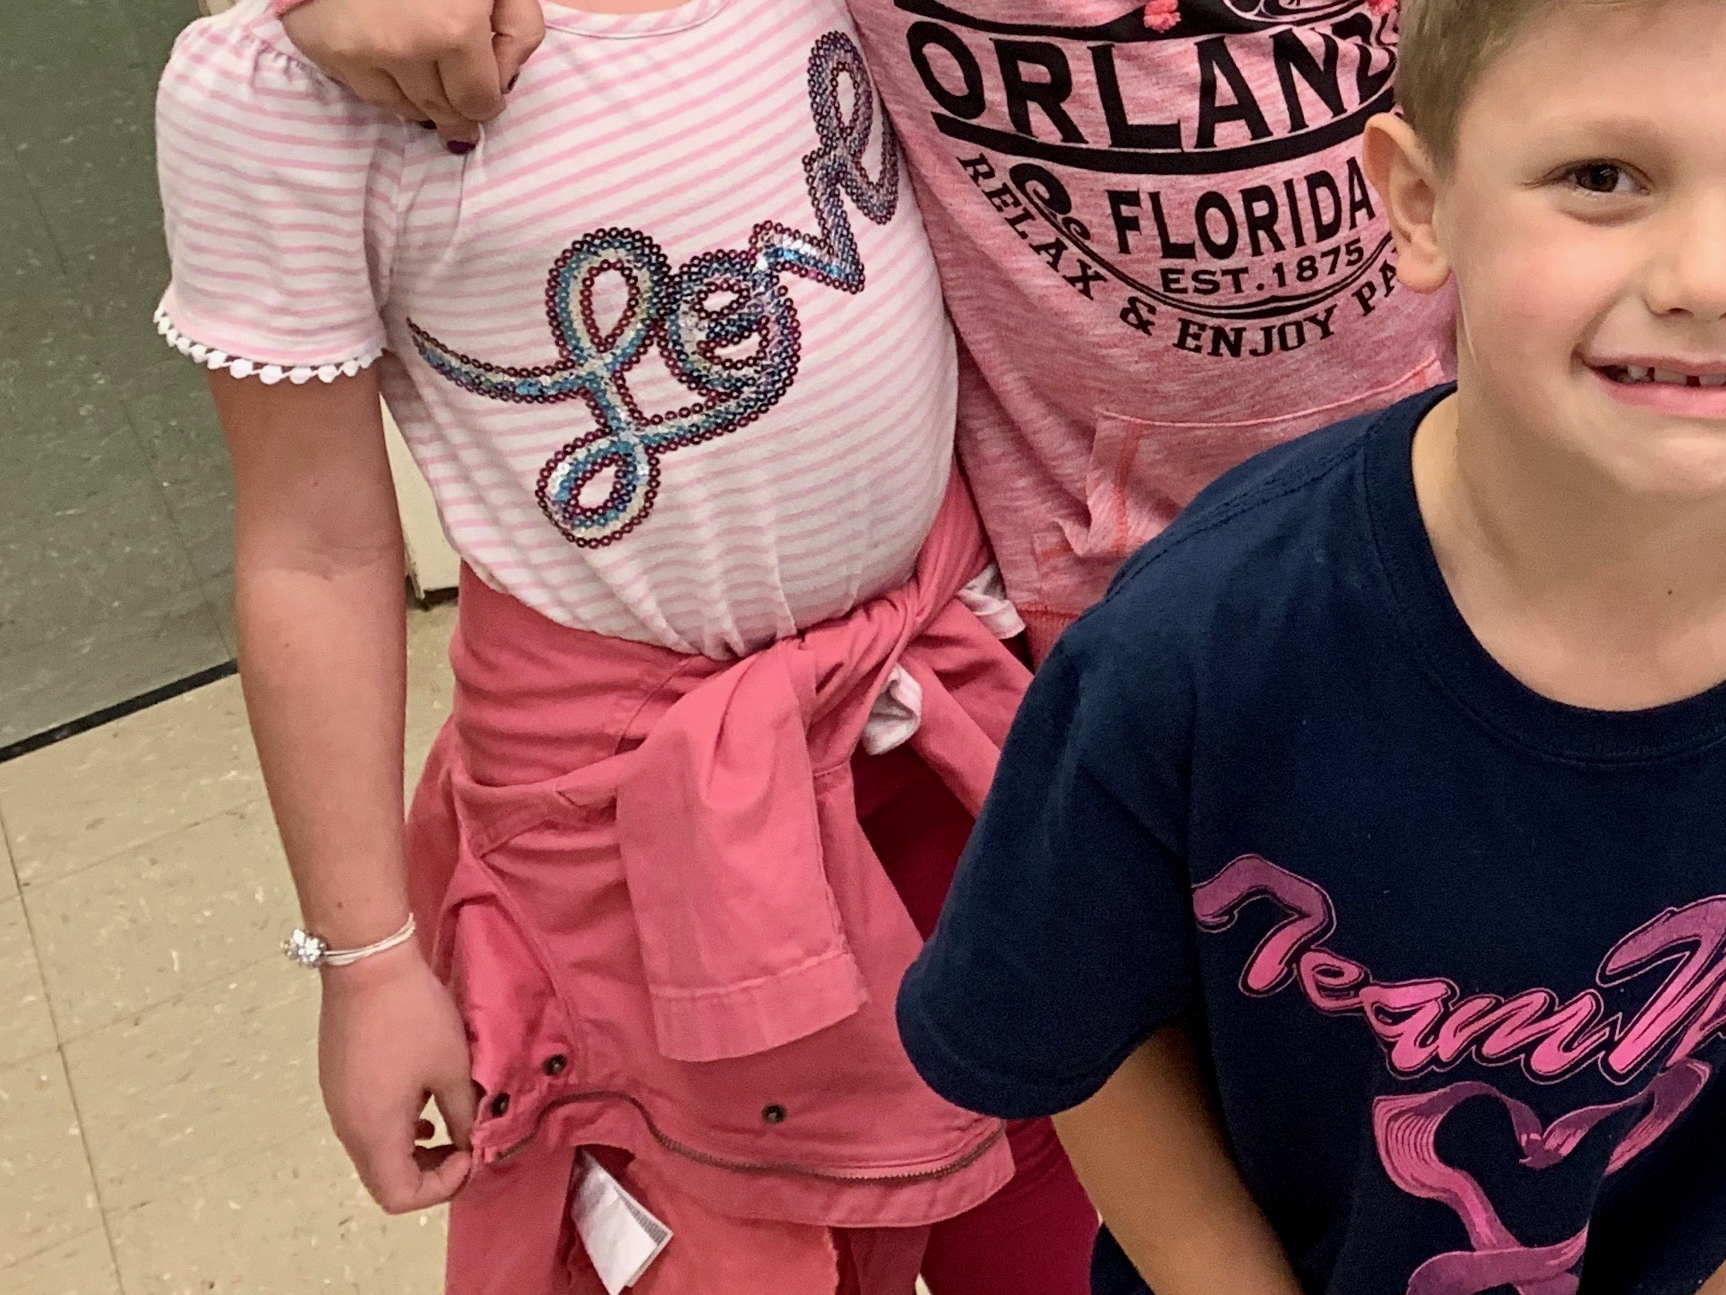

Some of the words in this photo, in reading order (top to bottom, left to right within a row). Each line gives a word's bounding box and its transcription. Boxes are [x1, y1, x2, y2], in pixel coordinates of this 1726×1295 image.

[906, 19, 1397, 151] ORLAND
[957, 153, 1107, 301] RELAX
[1120, 295, 1159, 336] &
[1173, 305, 1338, 358] ENJOY
[1106, 156, 1375, 262] FLORIDA
[1192, 854, 1604, 1079] Team
